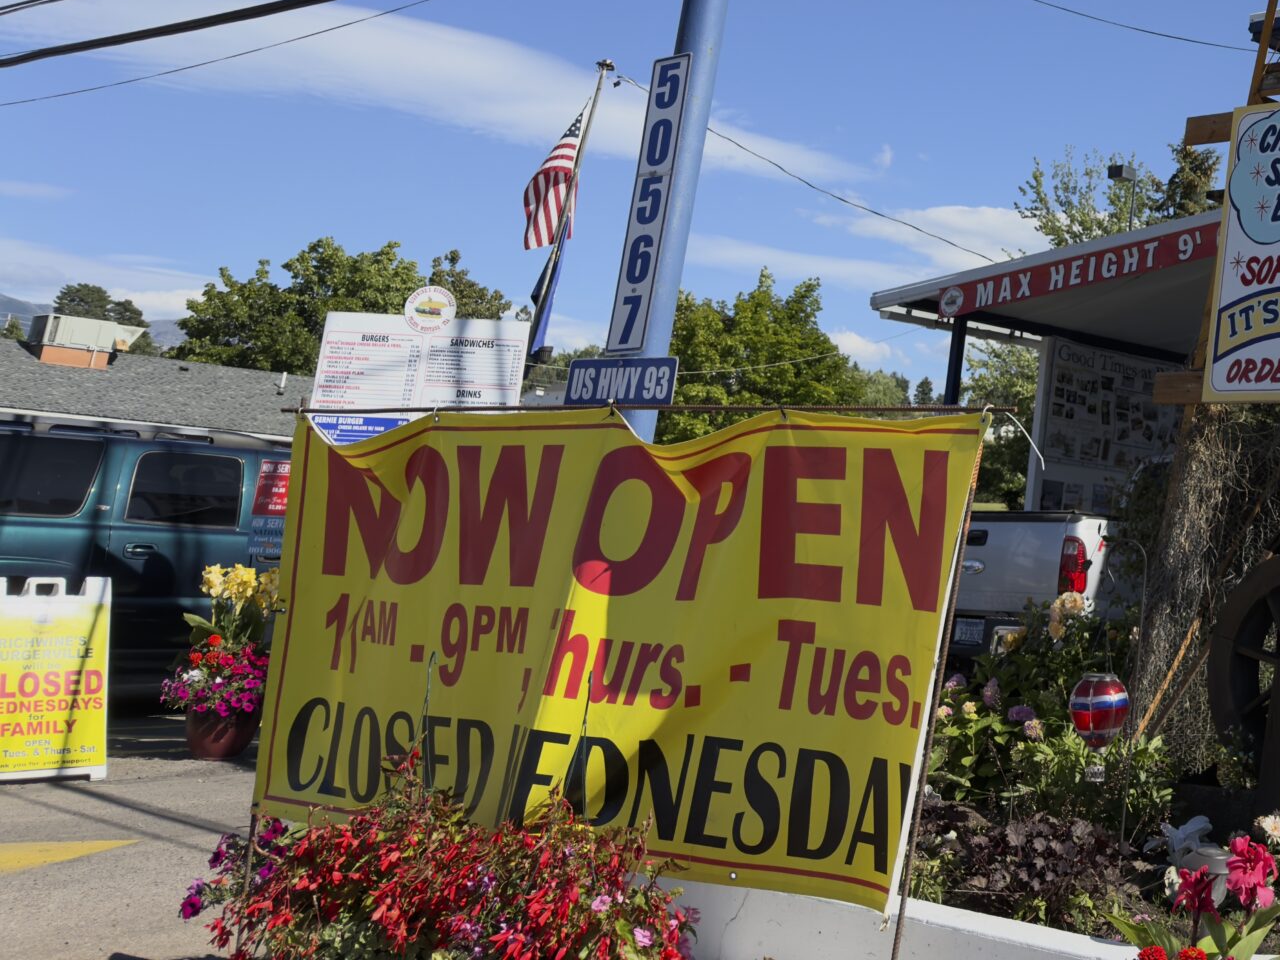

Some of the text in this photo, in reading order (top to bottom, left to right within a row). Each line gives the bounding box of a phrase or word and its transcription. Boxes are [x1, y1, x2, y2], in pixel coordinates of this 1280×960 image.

[975, 230, 1202, 309] MAX HEIGHT 9'
[1227, 298, 1280, 338] IT'S
[361, 334, 389, 344] BURGERS
[450, 338, 495, 349] SANDWICHES
[1058, 344, 1138, 379] Good Times
[456, 389, 482, 399] DRINKS
[572, 366, 670, 400] US HWY 93
[338, 417, 364, 426] BURGER
[321, 444, 949, 613] NOW OPEN
[0, 648, 93, 661] URGERVILLE
[542, 608, 700, 712] hurs.
[777, 619, 921, 729] Tues.
[0, 670, 103, 699] LOSED
[0, 697, 103, 715] EDNESDAYS
[0, 720, 77, 737] FAMILY
[25, 739, 50, 748] OPEN
[286, 696, 912, 876] CLOSED EDNESDA
